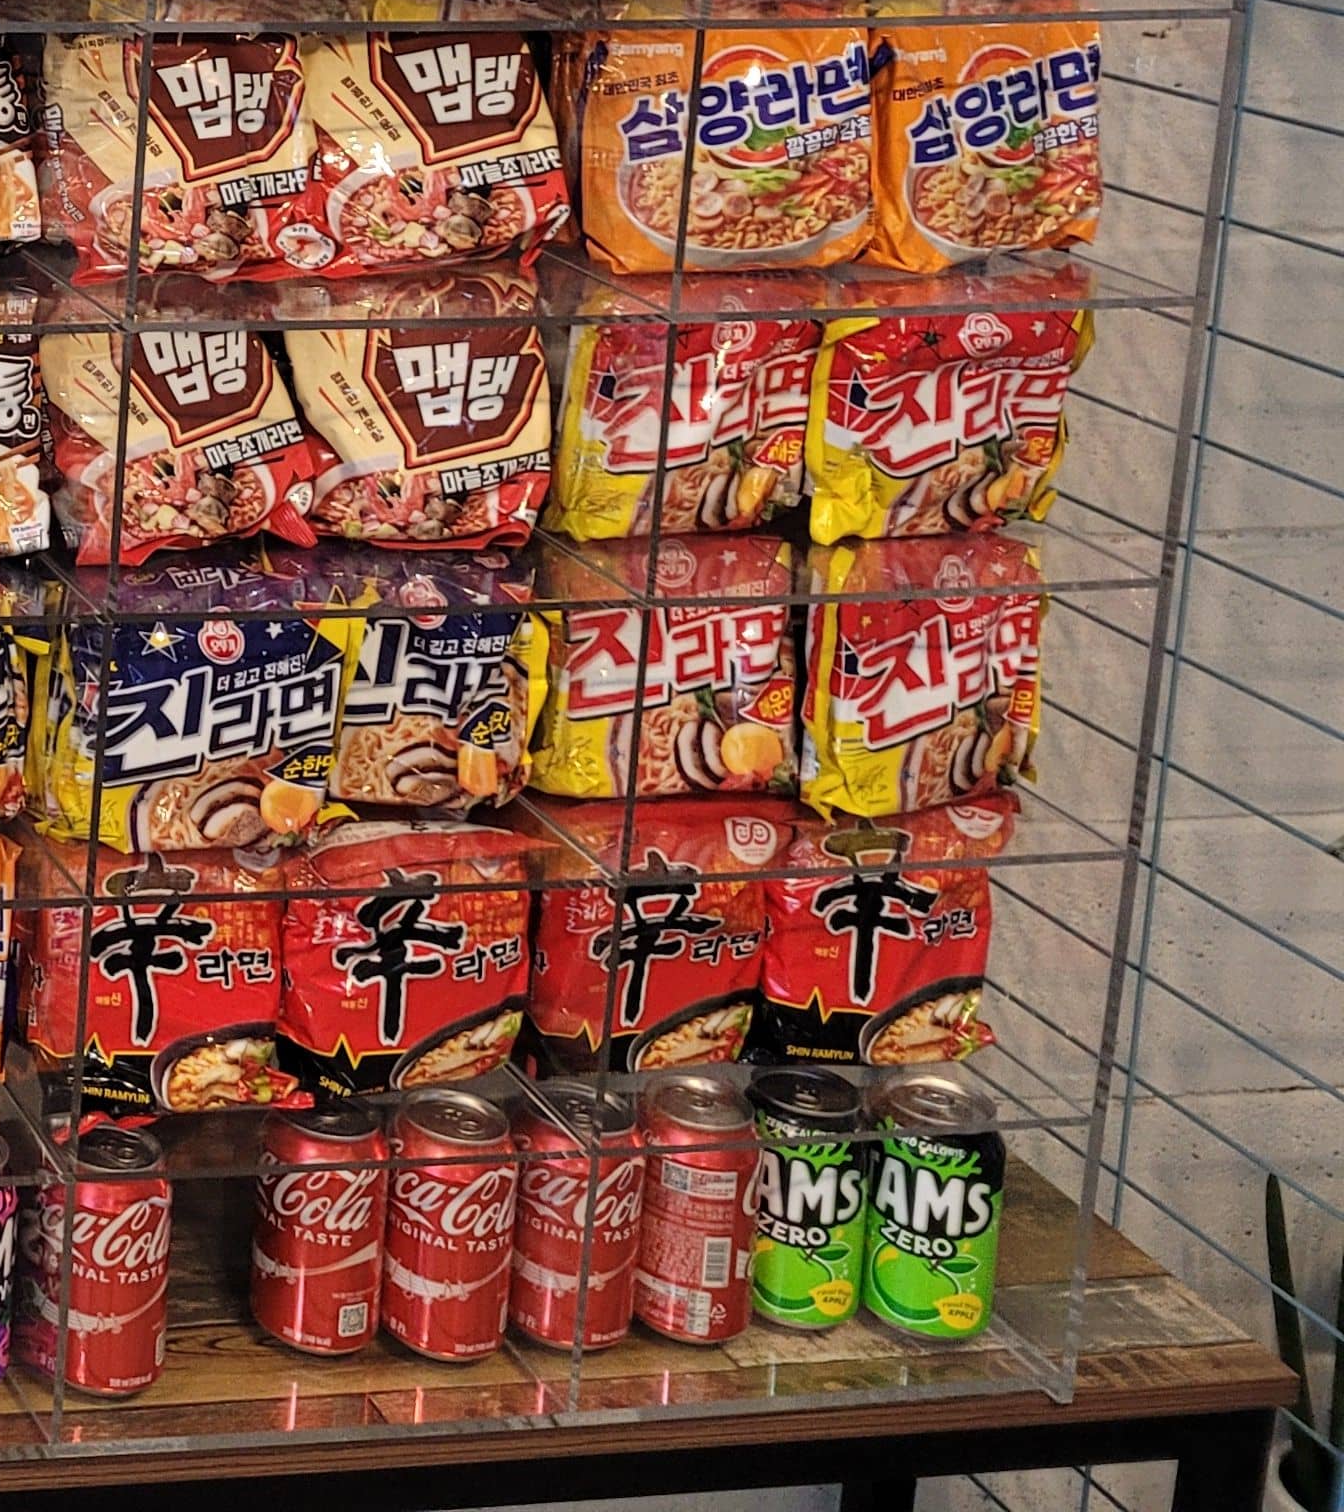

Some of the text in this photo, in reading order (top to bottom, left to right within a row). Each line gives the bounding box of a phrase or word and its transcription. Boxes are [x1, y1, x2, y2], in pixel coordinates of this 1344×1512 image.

[156, 57, 271, 140] 맵탱
[395, 43, 522, 125] 맵탱
[620, 43, 872, 162] 삼양라면
[785, 123, 837, 159] 깔끔한
[139, 330, 248, 406] 맵탱
[393, 342, 521, 428] 맵탱
[205, 419, 305, 470] 마늘조개라면
[207, 636, 236, 654] 오뚜기
[428, 634, 511, 656] 깊고 진해진!
[217, 654, 309, 692] 더 깊고 진해진!
[102, 664, 341, 789] 진라면
[813, 820, 939, 1004] 辛
[922, 909, 978, 944] 라면
[89, 852, 217, 1047] 辛
[335, 867, 469, 1046] 辛
[589, 847, 723, 1027] 辛
[690, 929, 760, 963] 라면
[197, 948, 274, 987] 라면
[454, 938, 521, 982] 라면
[786, 1045, 854, 1061] SHIN RAMYUN
[105, 1085, 150, 1104] RAMYUN
[873, 1163, 992, 1238] AMS
[294, 1225, 352, 1248] TASTE
[758, 1214, 829, 1249] ZERO
[880, 1219, 956, 1259] ZERO
